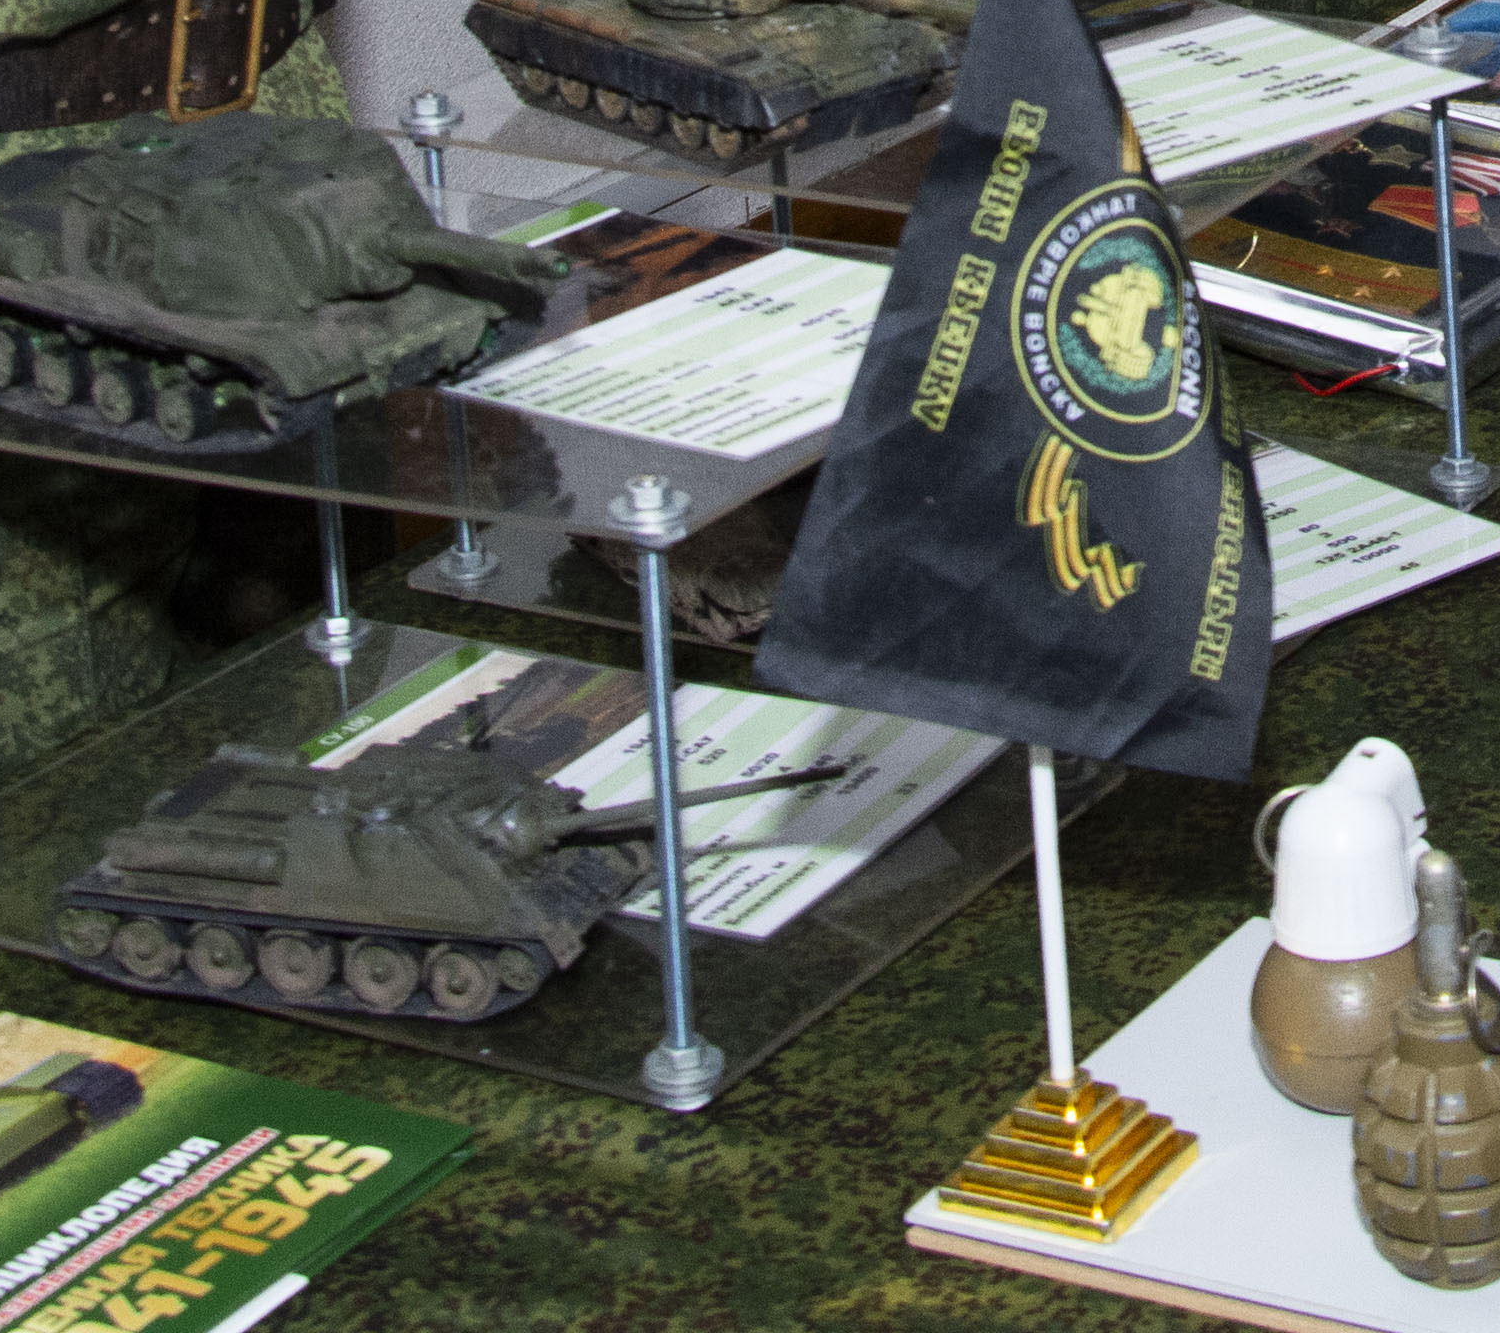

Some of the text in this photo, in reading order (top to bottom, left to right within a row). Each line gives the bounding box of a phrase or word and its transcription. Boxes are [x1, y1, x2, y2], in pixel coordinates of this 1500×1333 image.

[8, 1134, 333, 1333] ЕННАЯ ТЕХНИКА
[63, 1140, 393, 1333] 41-1945
